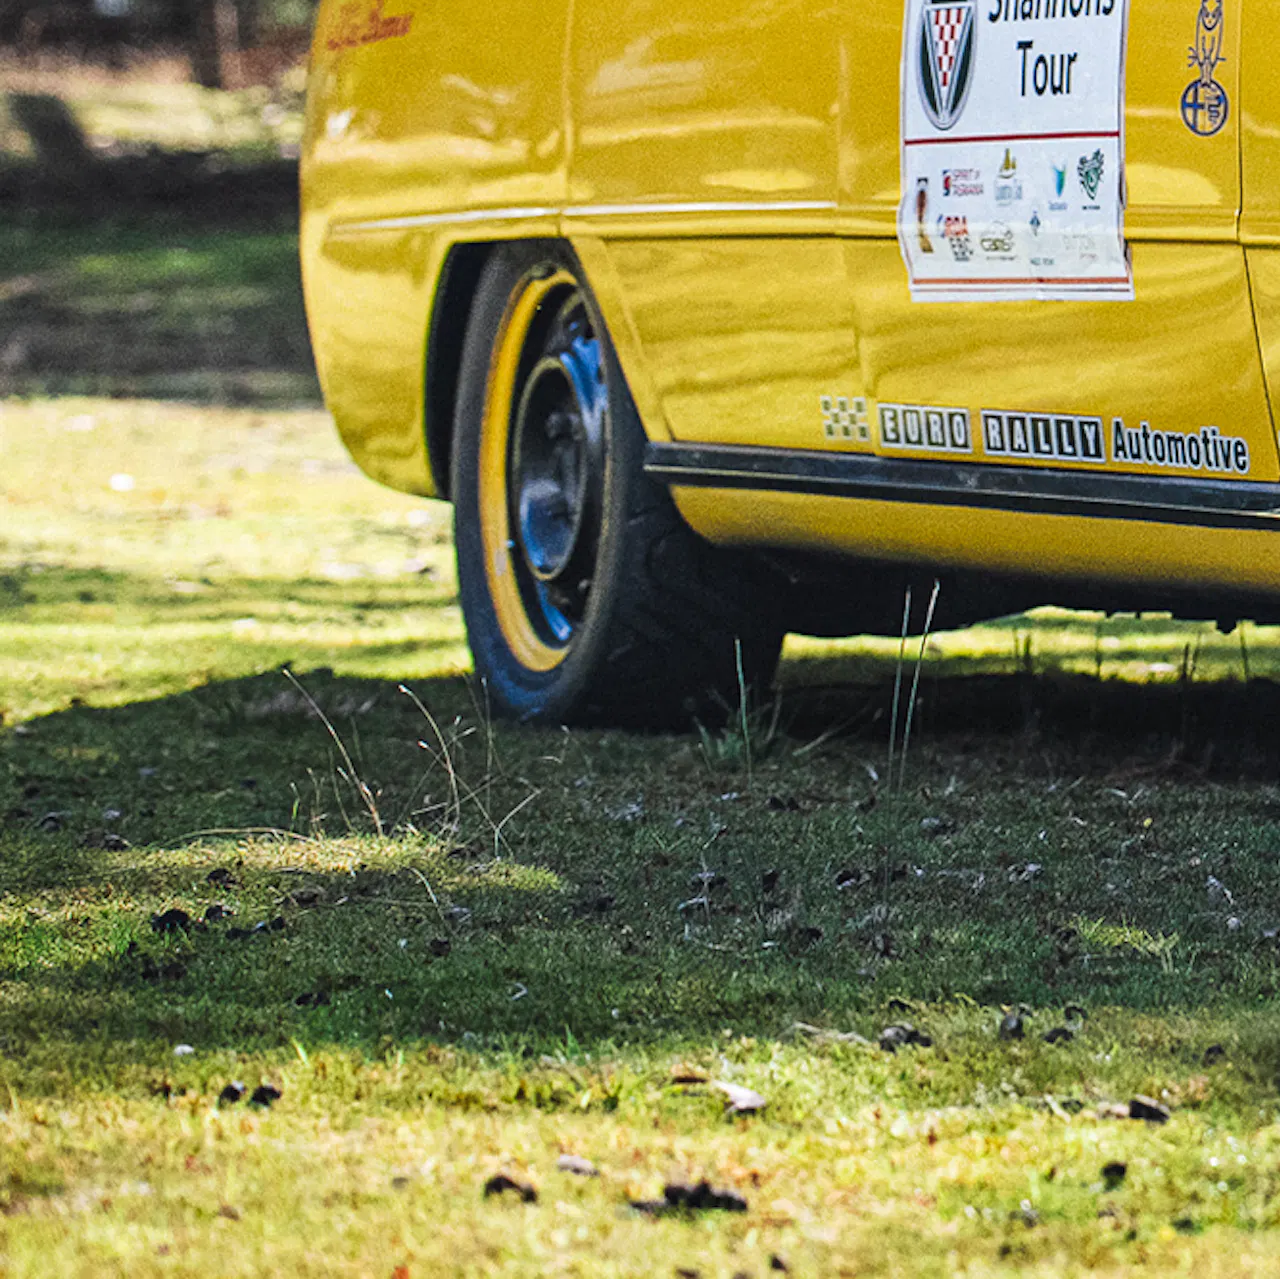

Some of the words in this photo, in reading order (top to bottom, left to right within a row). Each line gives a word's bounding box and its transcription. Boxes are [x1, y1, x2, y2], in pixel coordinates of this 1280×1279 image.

[1016, 39, 1079, 97] Tour
[881, 406, 969, 449] EURO
[985, 414, 1101, 458] RALLY
[1113, 419, 1249, 472] Automotive
